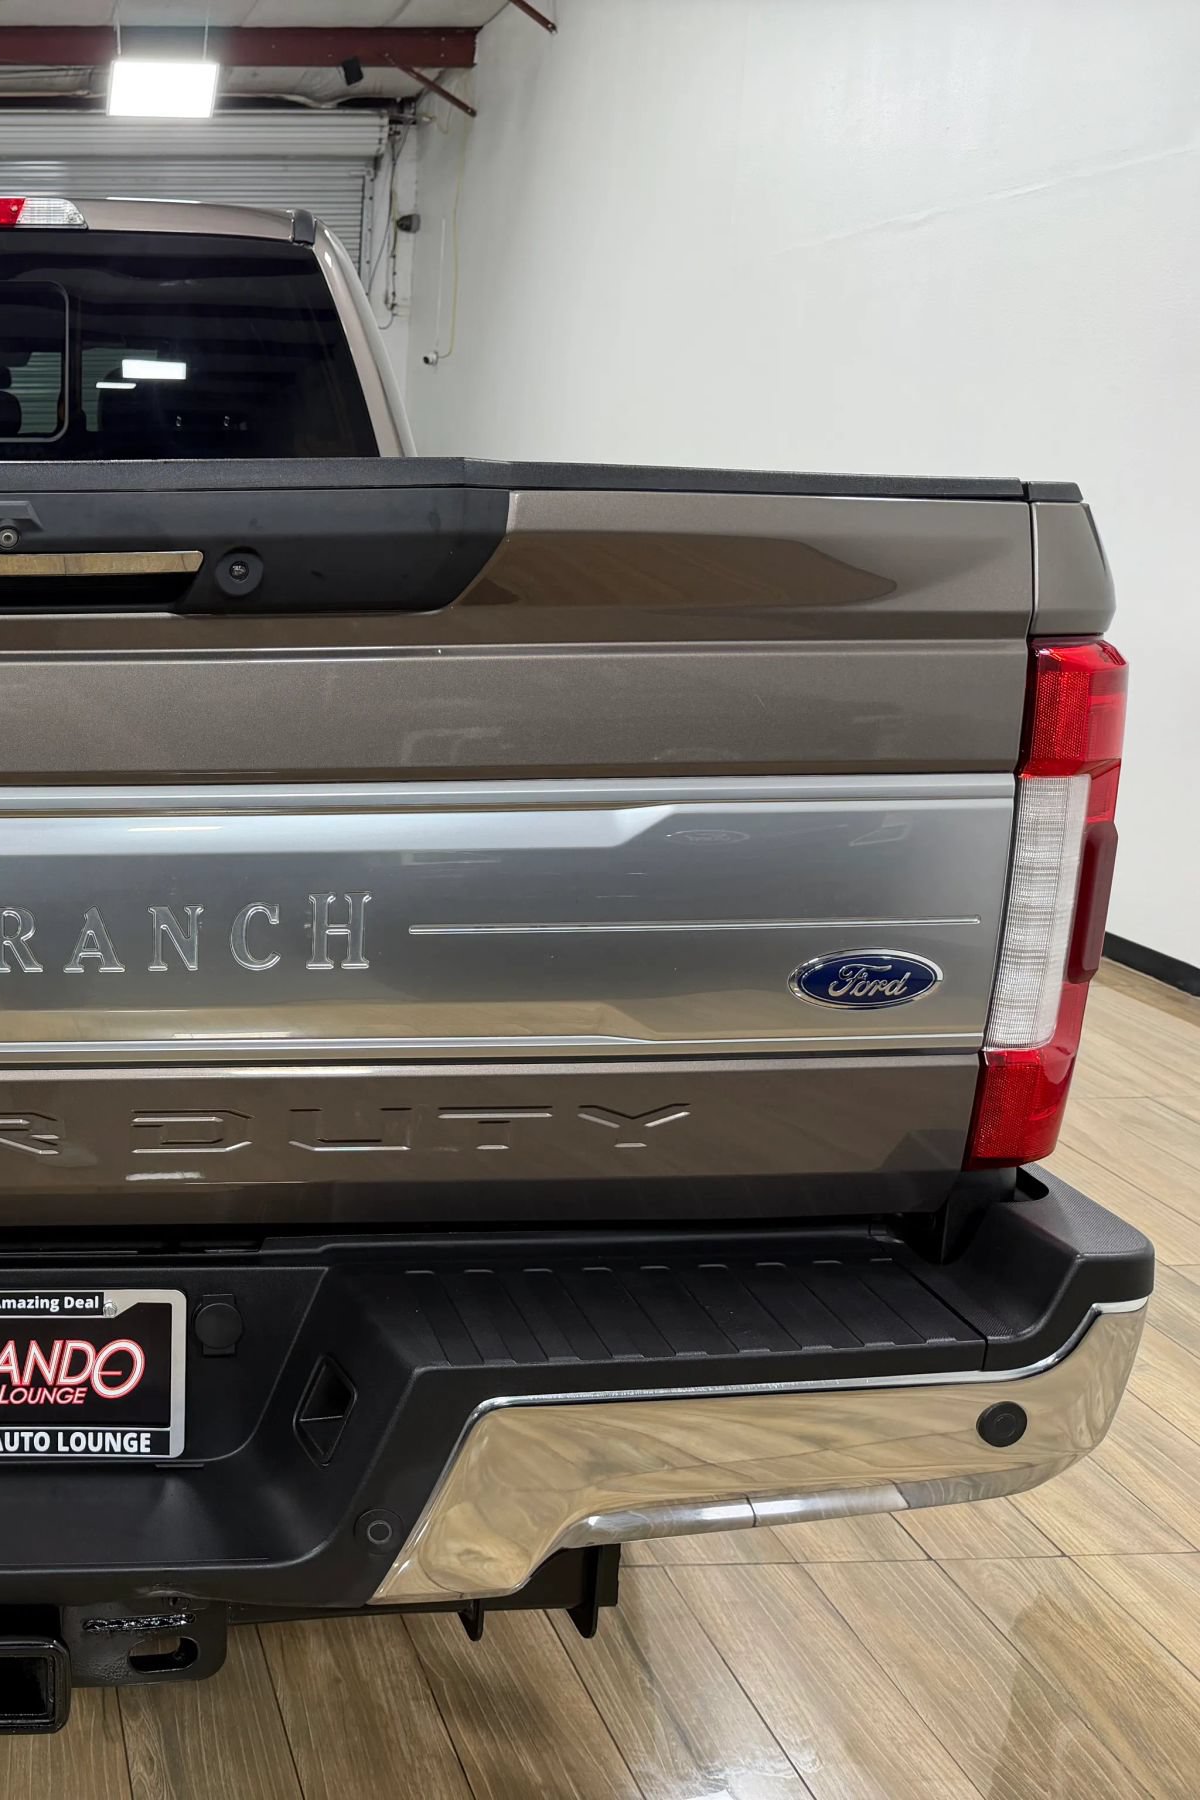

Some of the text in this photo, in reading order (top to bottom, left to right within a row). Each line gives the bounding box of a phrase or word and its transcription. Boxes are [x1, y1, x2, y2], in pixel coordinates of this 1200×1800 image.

[828, 963, 912, 997] Ford
[131, 1102, 692, 1154] DUTY
[63, 1296, 99, 1310] Deal
[57, 1432, 152, 1454] LOUNGE
